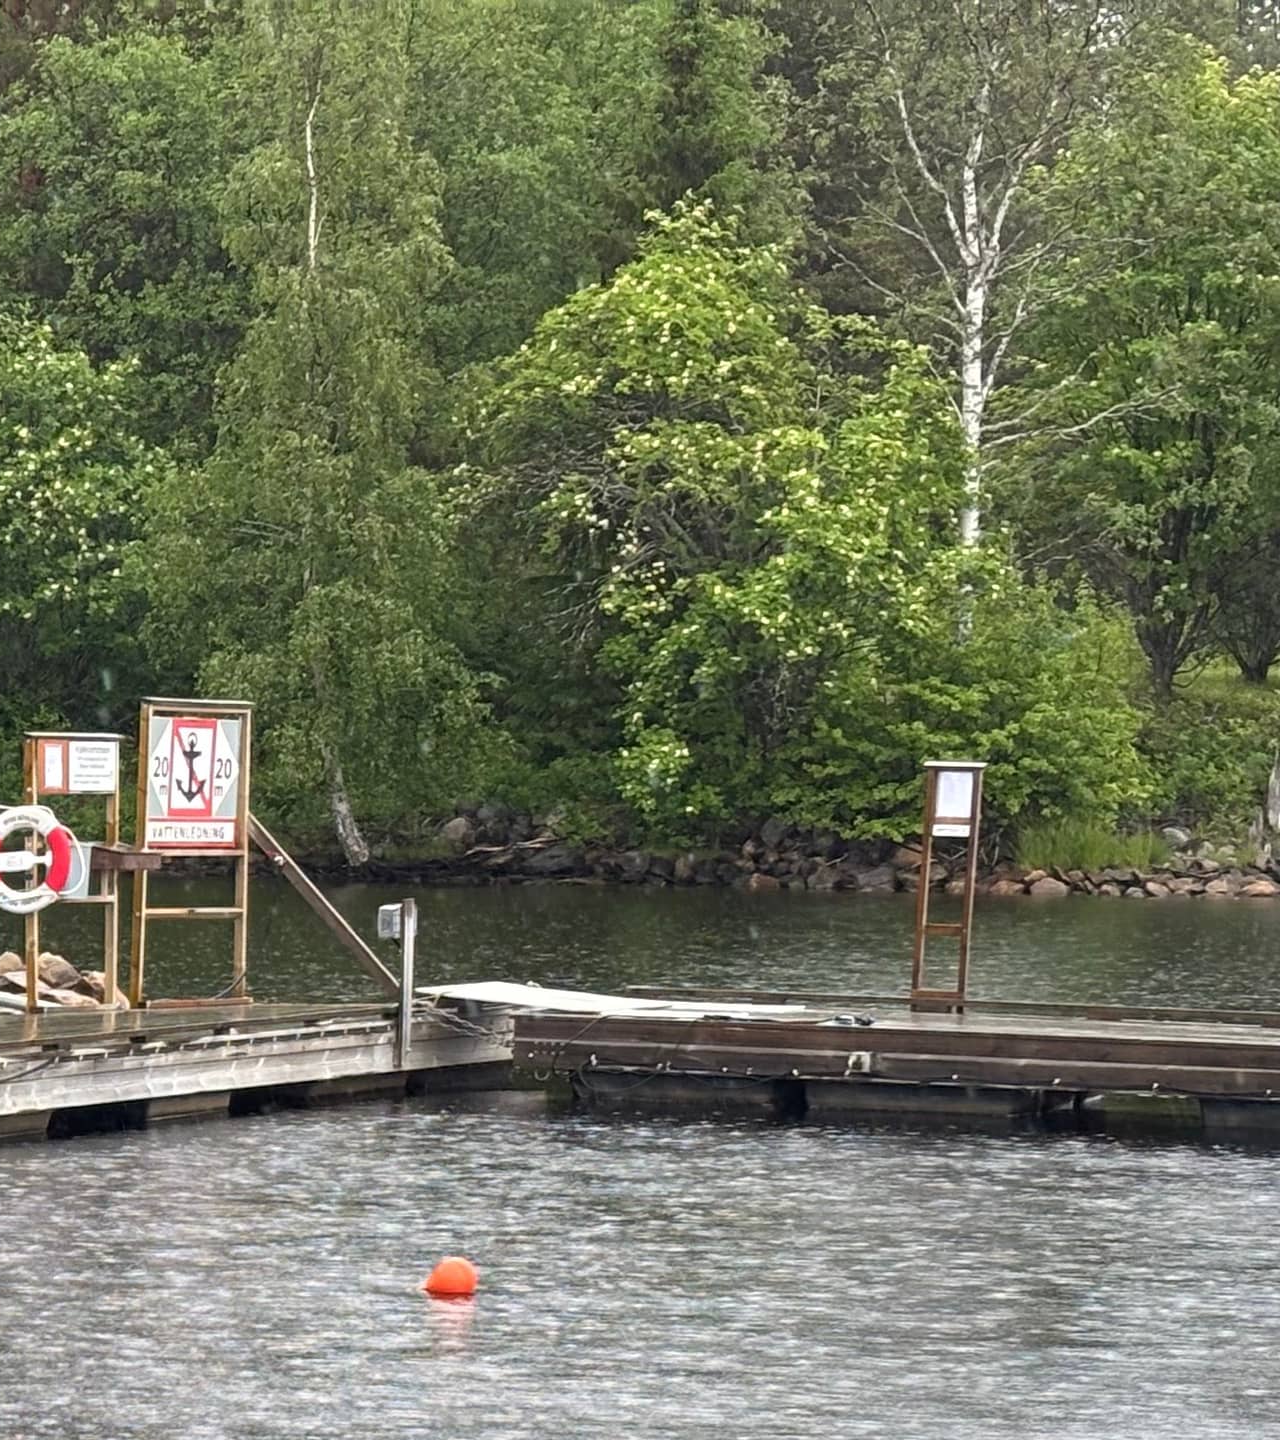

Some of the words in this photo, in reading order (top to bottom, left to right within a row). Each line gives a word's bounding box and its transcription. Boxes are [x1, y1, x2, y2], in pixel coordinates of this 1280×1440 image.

[153, 756, 169, 778] 20
[215, 758, 232, 780] 20
[159, 785, 168, 796] m
[214, 786, 224, 797] m
[152, 826, 225, 840] VATTENLEDNING
